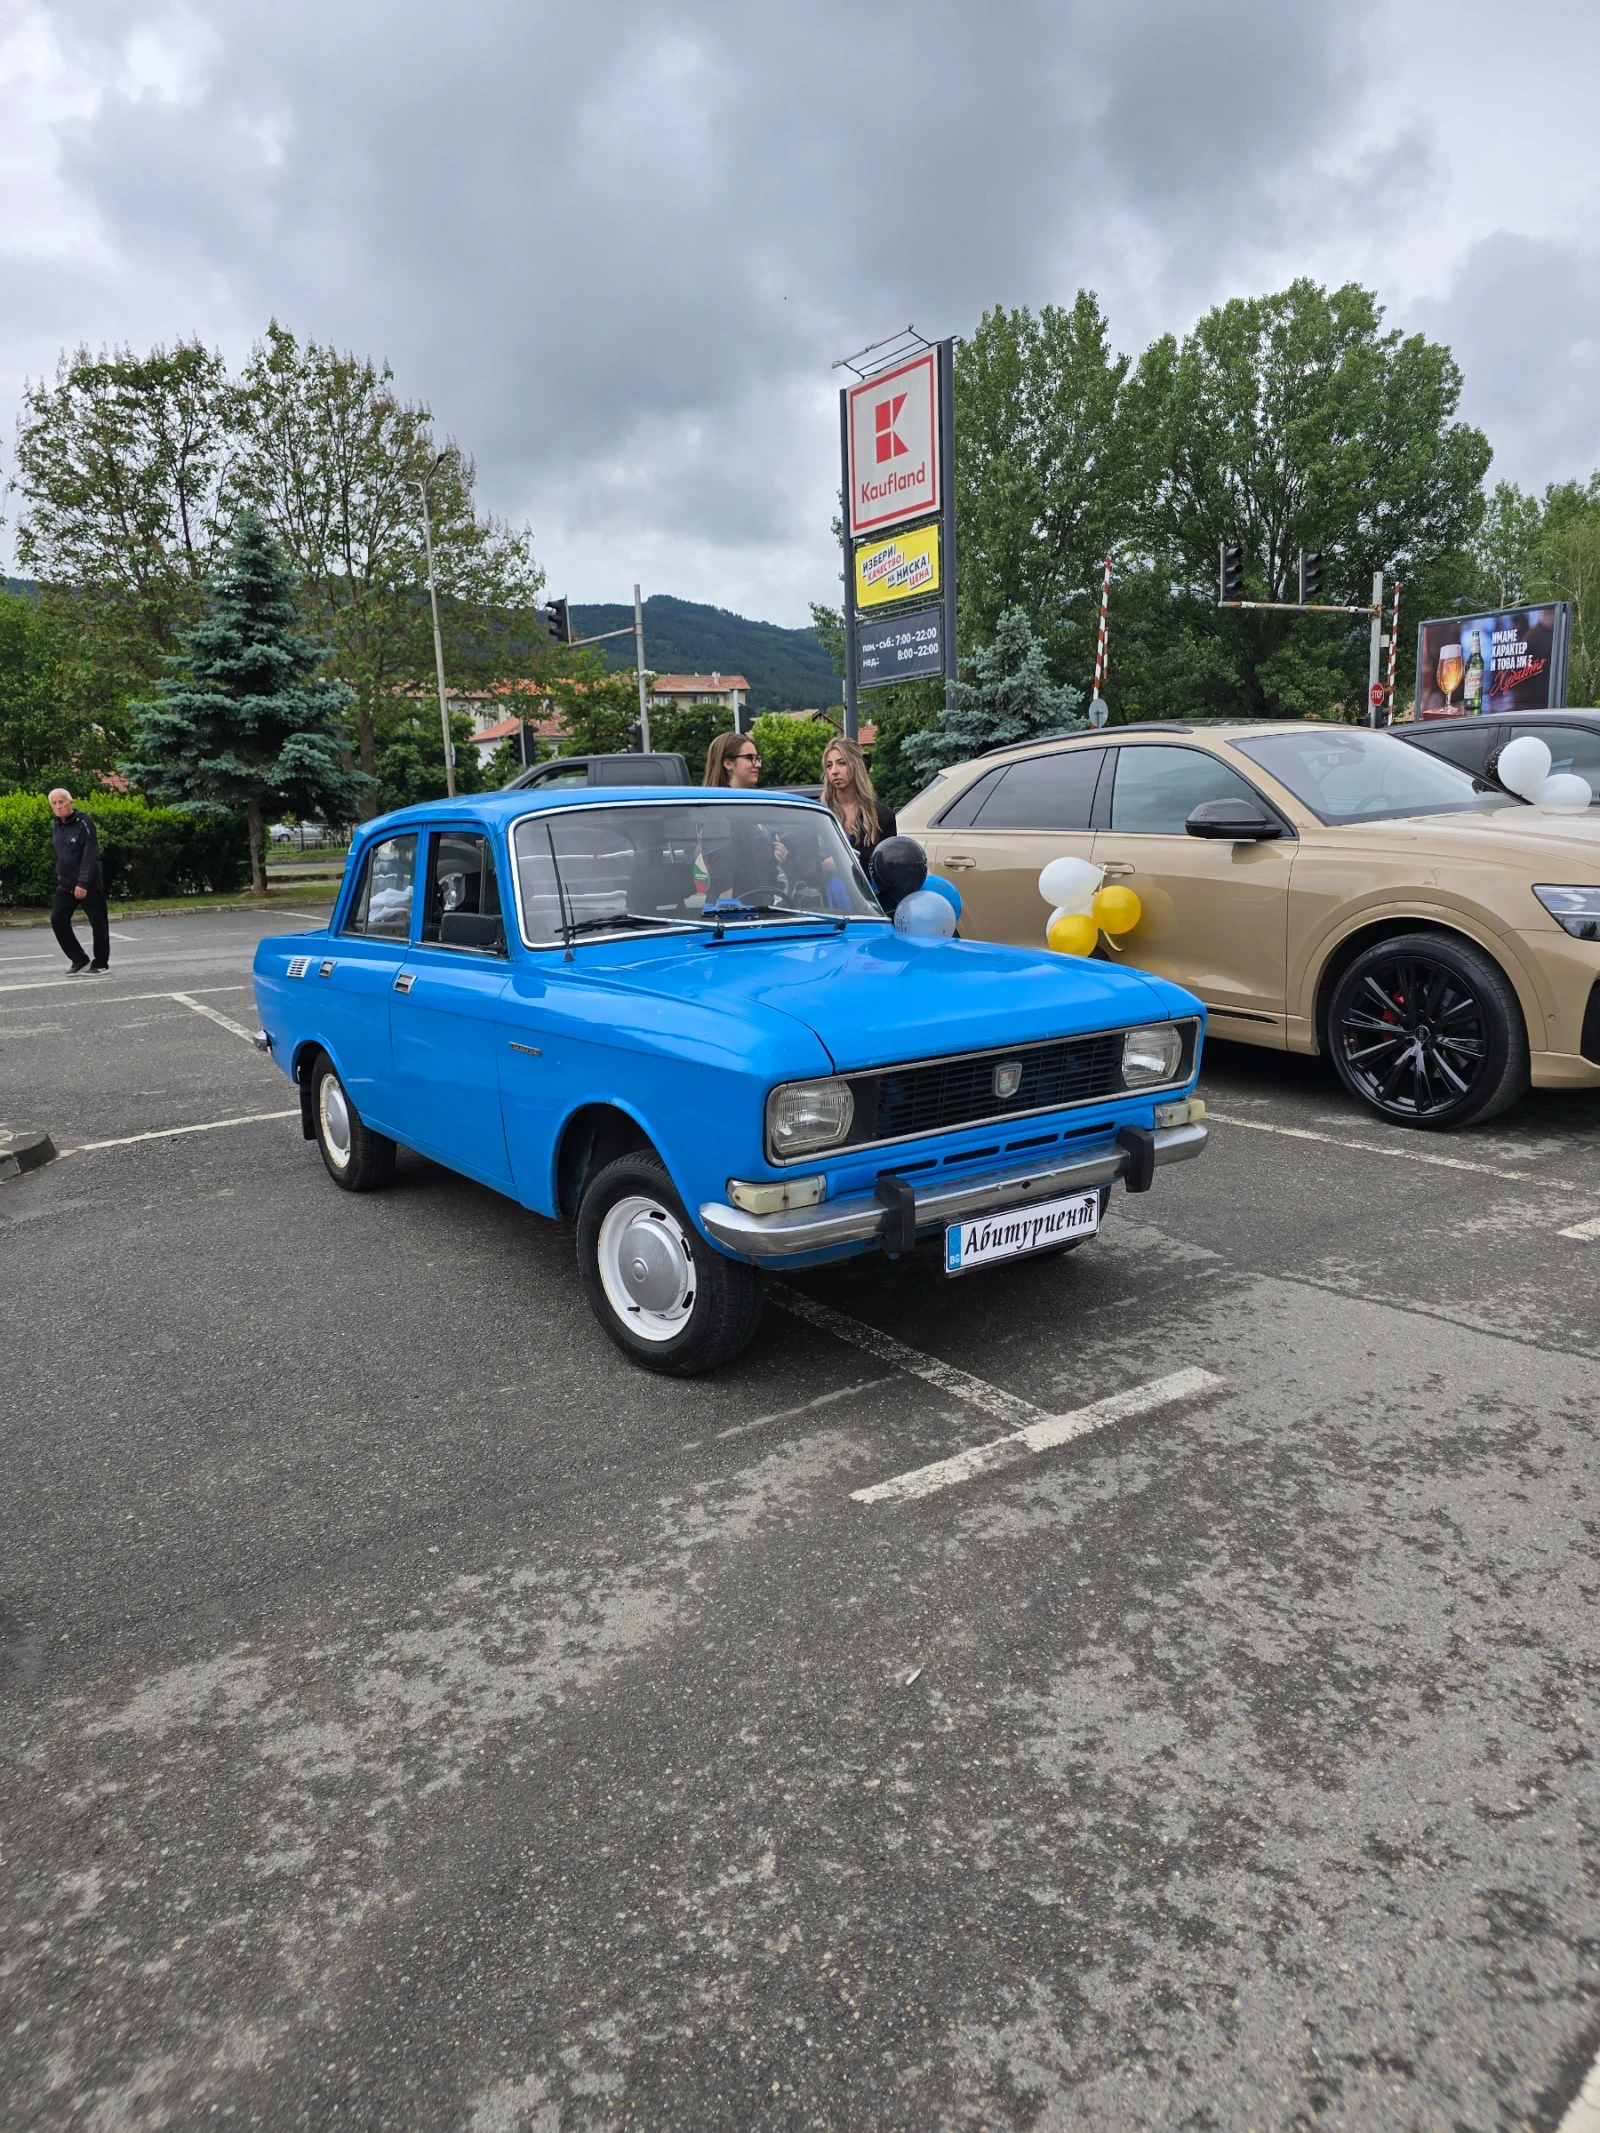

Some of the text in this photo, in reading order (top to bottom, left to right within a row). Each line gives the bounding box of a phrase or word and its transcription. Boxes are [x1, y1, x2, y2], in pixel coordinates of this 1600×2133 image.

[861, 461, 925, 503] Kaufland
[862, 546, 893, 574] ИЗБЕРИ
[867, 554, 902, 582] КАЧЕСТВО
[887, 556, 927, 584] НА НИСКА
[909, 567, 930, 586] ЦЕНА
[1491, 629, 1518, 644] ИМАМЕ
[1491, 642, 1528, 657] ХАРАКТЕР
[1490, 659, 1496, 671] И
[1497, 657, 1515, 670] ТОВА
[1371, 690, 1383, 699] STOP
[964, 1205, 1094, 1256] Абитуриент
[949, 1254, 960, 1265] BG
